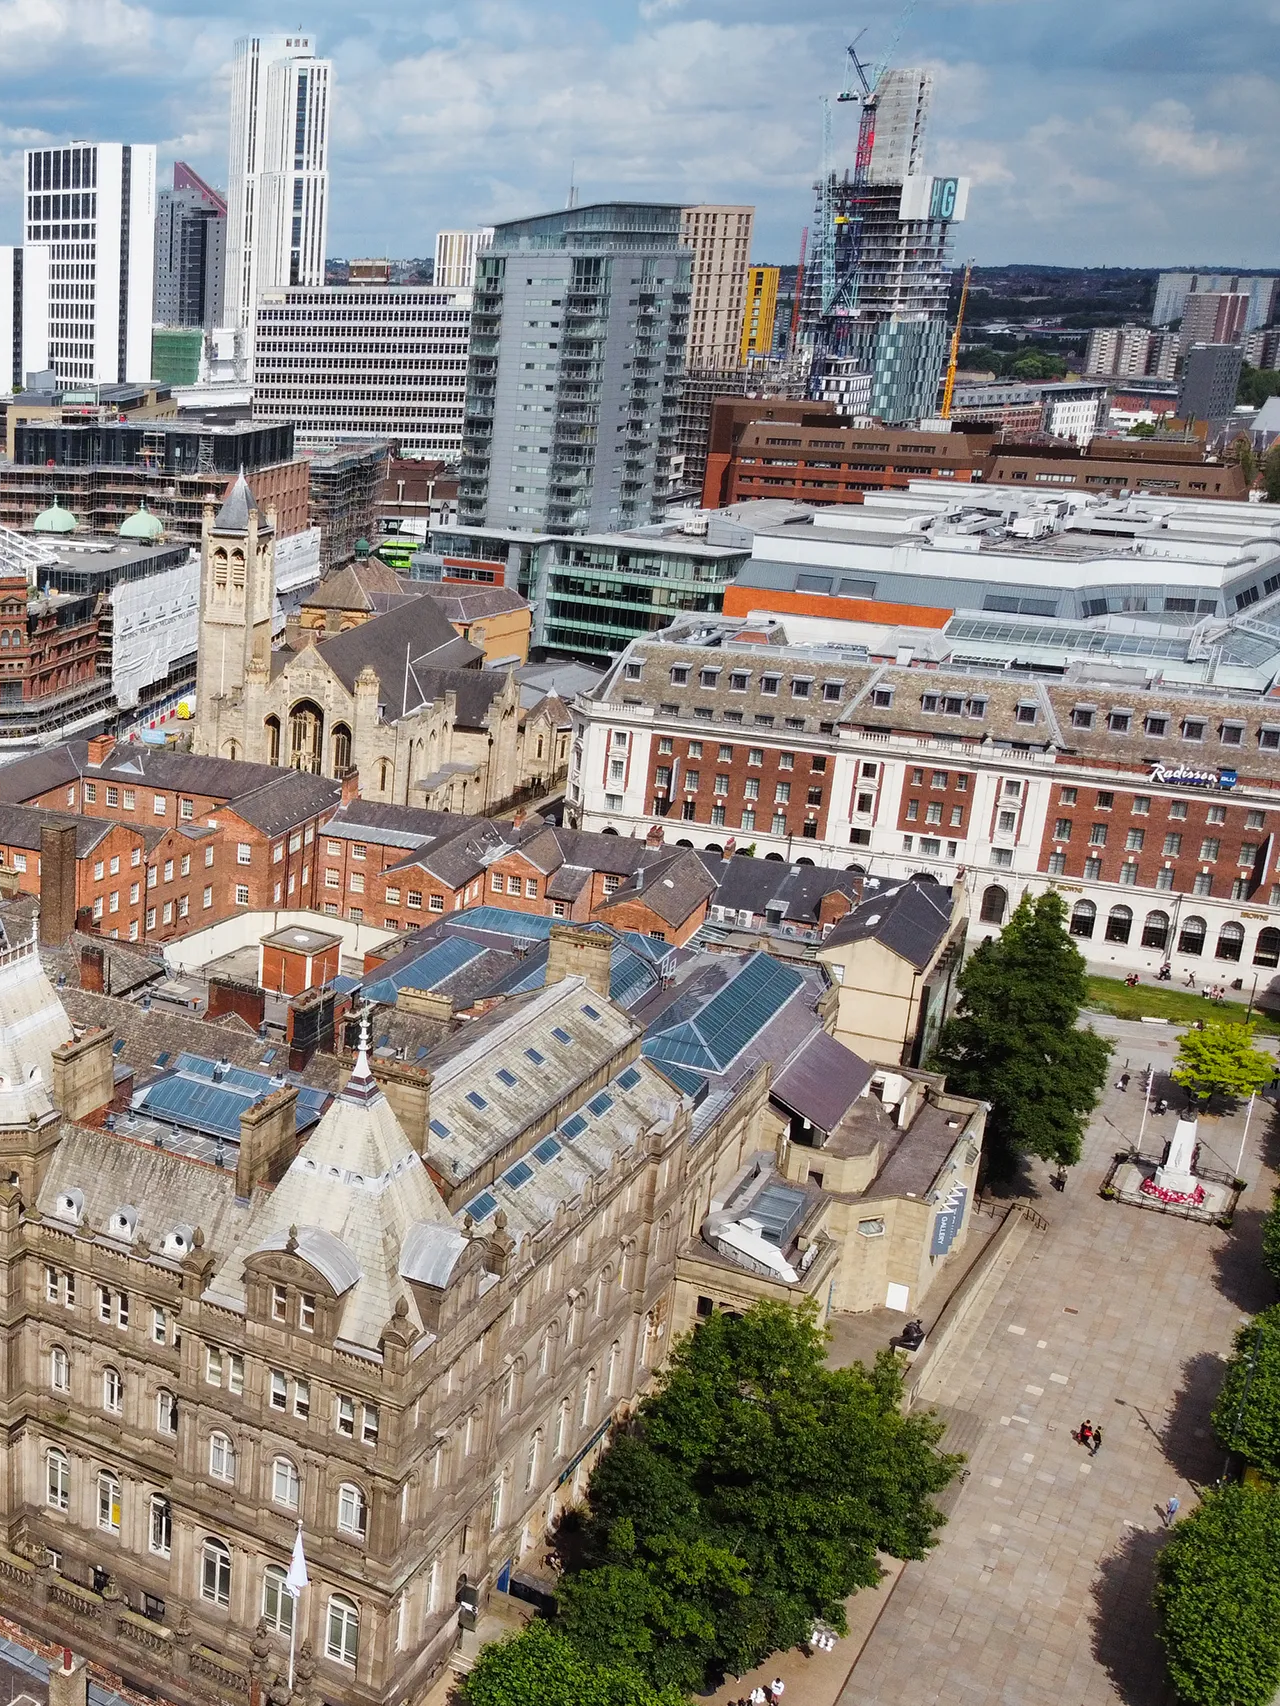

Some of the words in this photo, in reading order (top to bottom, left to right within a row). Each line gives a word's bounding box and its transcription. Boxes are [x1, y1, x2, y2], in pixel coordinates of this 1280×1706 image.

[1149, 763, 1218, 783] Radisson
[1057, 884, 1083, 894] BROWNS
[1240, 911, 1268, 921] BROWNS
[937, 1216, 948, 1245] GALLERY
